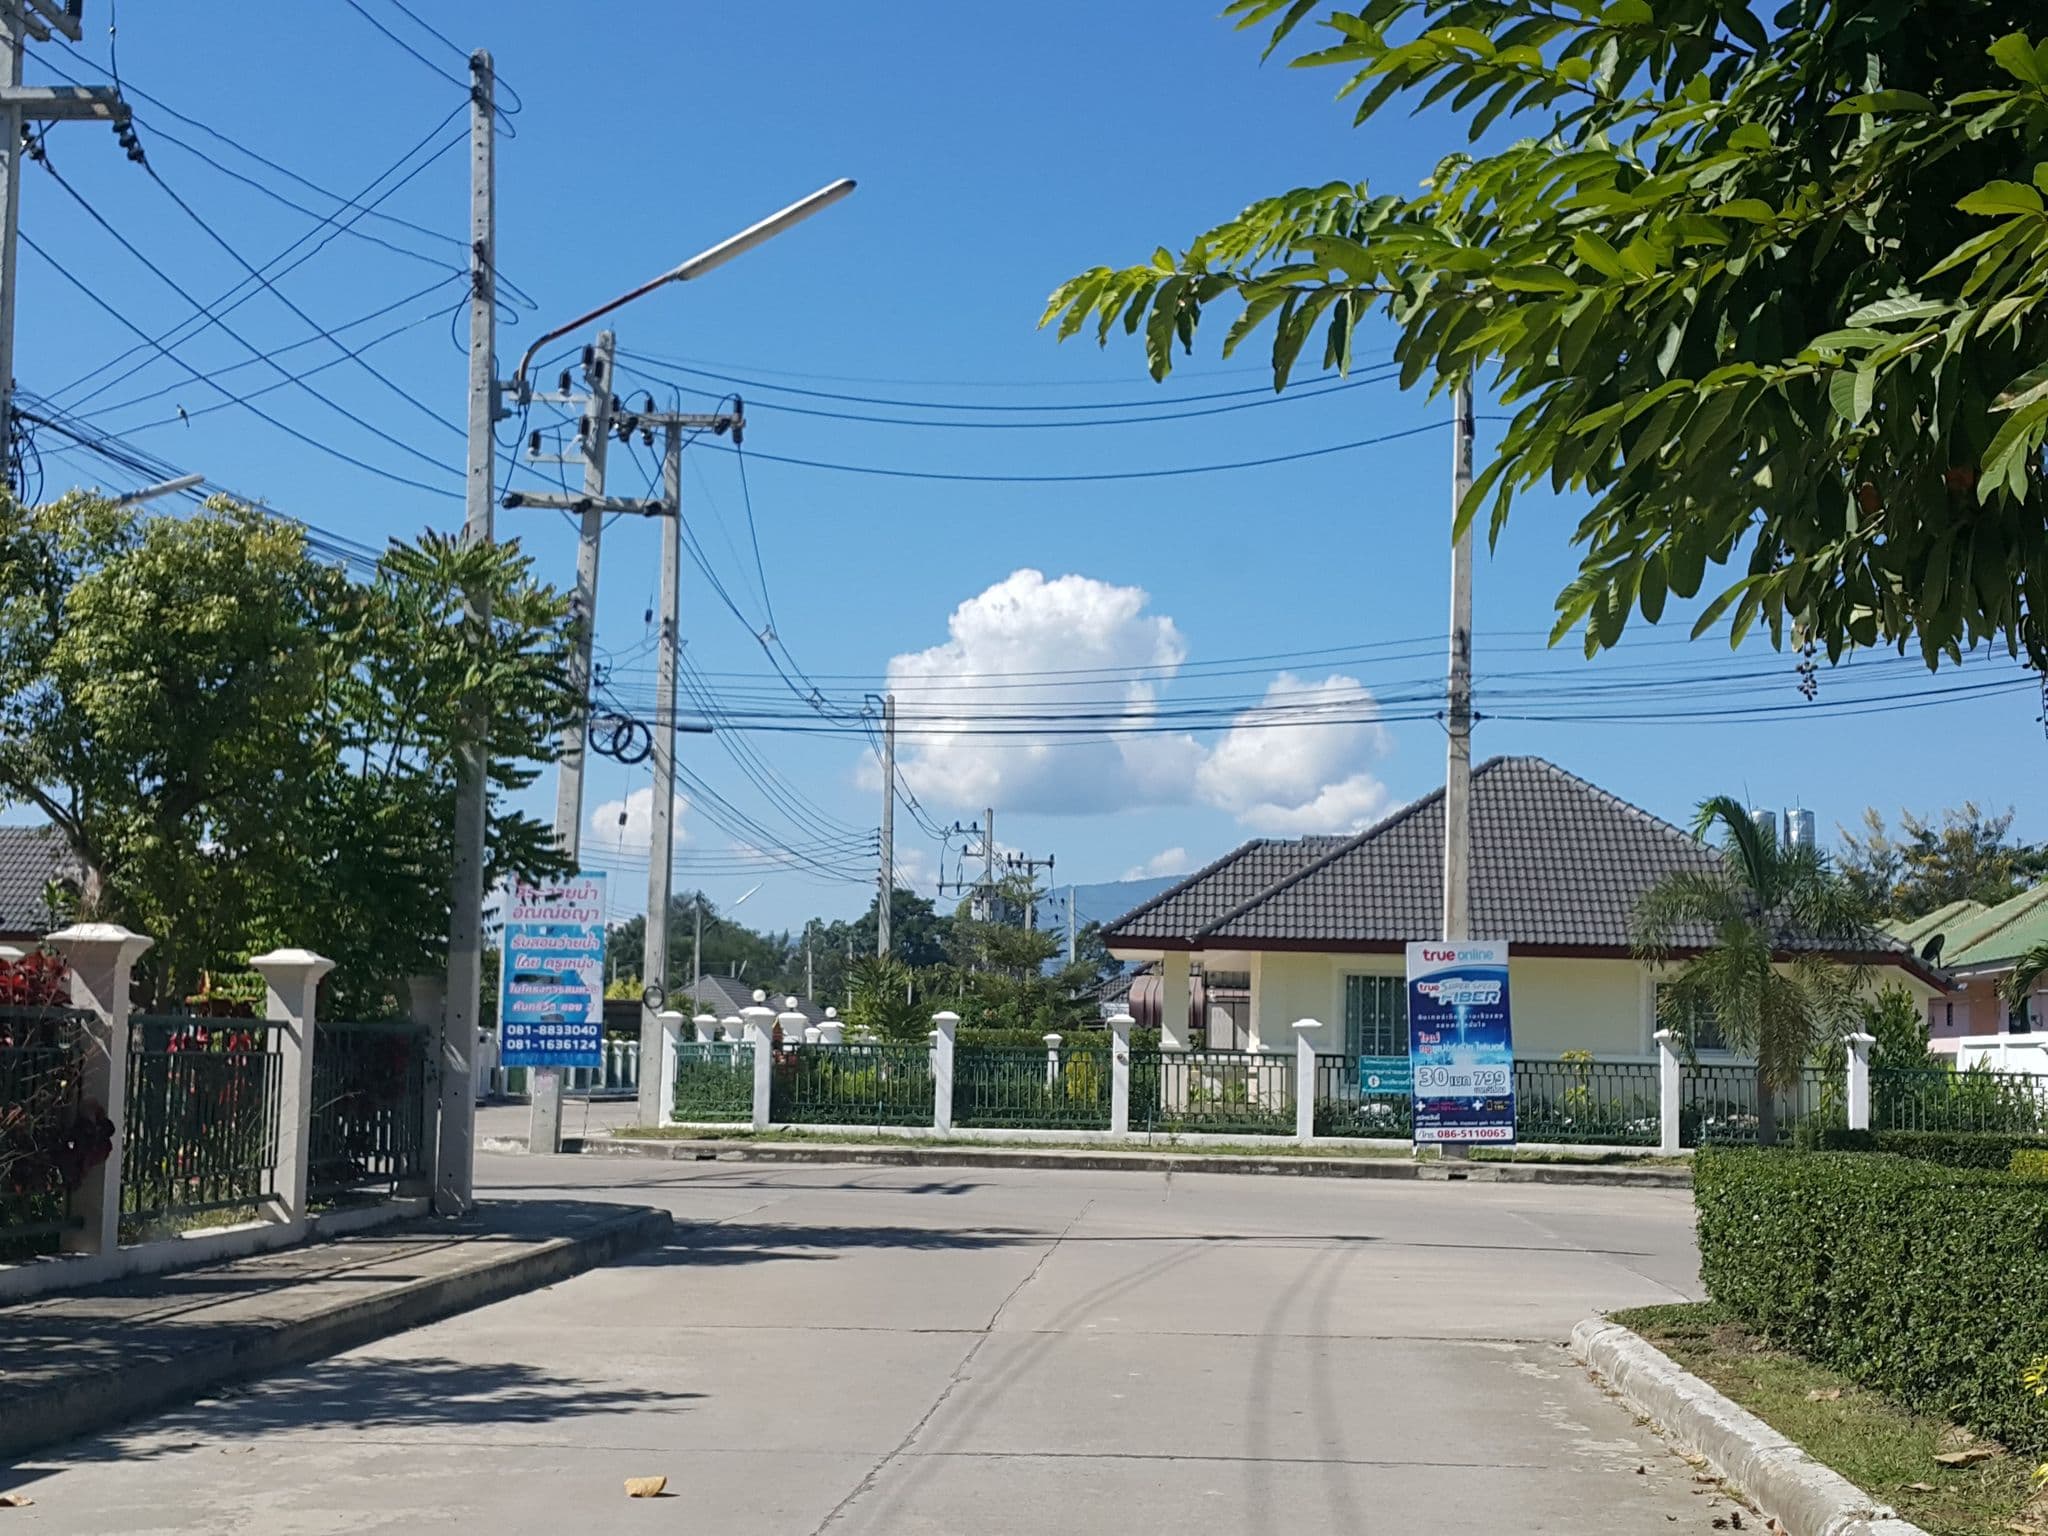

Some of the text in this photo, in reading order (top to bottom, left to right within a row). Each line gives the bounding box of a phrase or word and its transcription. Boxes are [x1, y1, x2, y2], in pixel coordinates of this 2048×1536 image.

[1423, 948, 1494, 961] true online
[516, 954, 541, 968] โดย
[1419, 982, 1440, 991] true
[1440, 991, 1499, 1003] FIBER
[507, 1025, 597, 1036] 081-8833040
[507, 1039, 597, 1050] 081-1636124
[1419, 1067, 1449, 1087] 30
[1473, 1071, 1505, 1085] 799
[1437, 1129, 1506, 1138] 086-5110065
